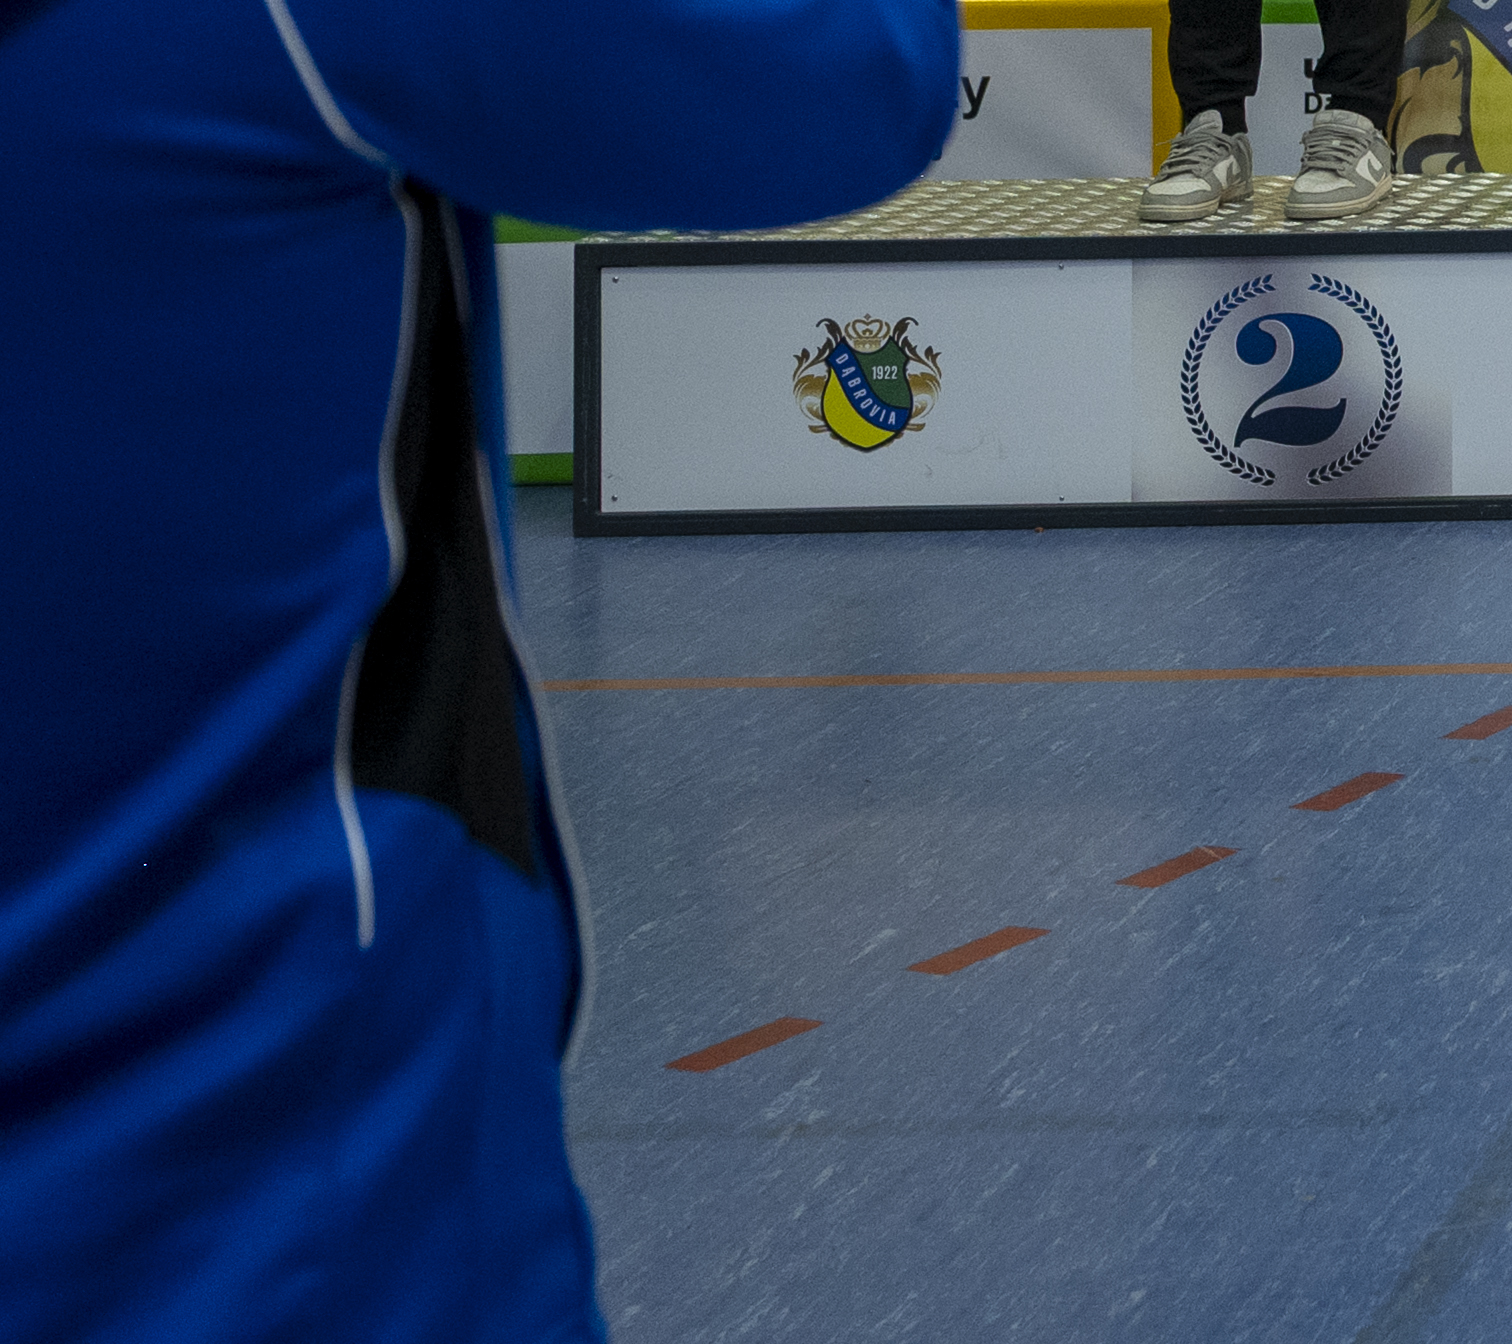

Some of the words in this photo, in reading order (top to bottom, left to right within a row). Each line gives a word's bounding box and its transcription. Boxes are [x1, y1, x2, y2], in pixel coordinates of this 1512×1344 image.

[831, 349, 902, 429] DĄBROVIA
[872, 362, 900, 381] 1922
[1234, 310, 1349, 449] 2
